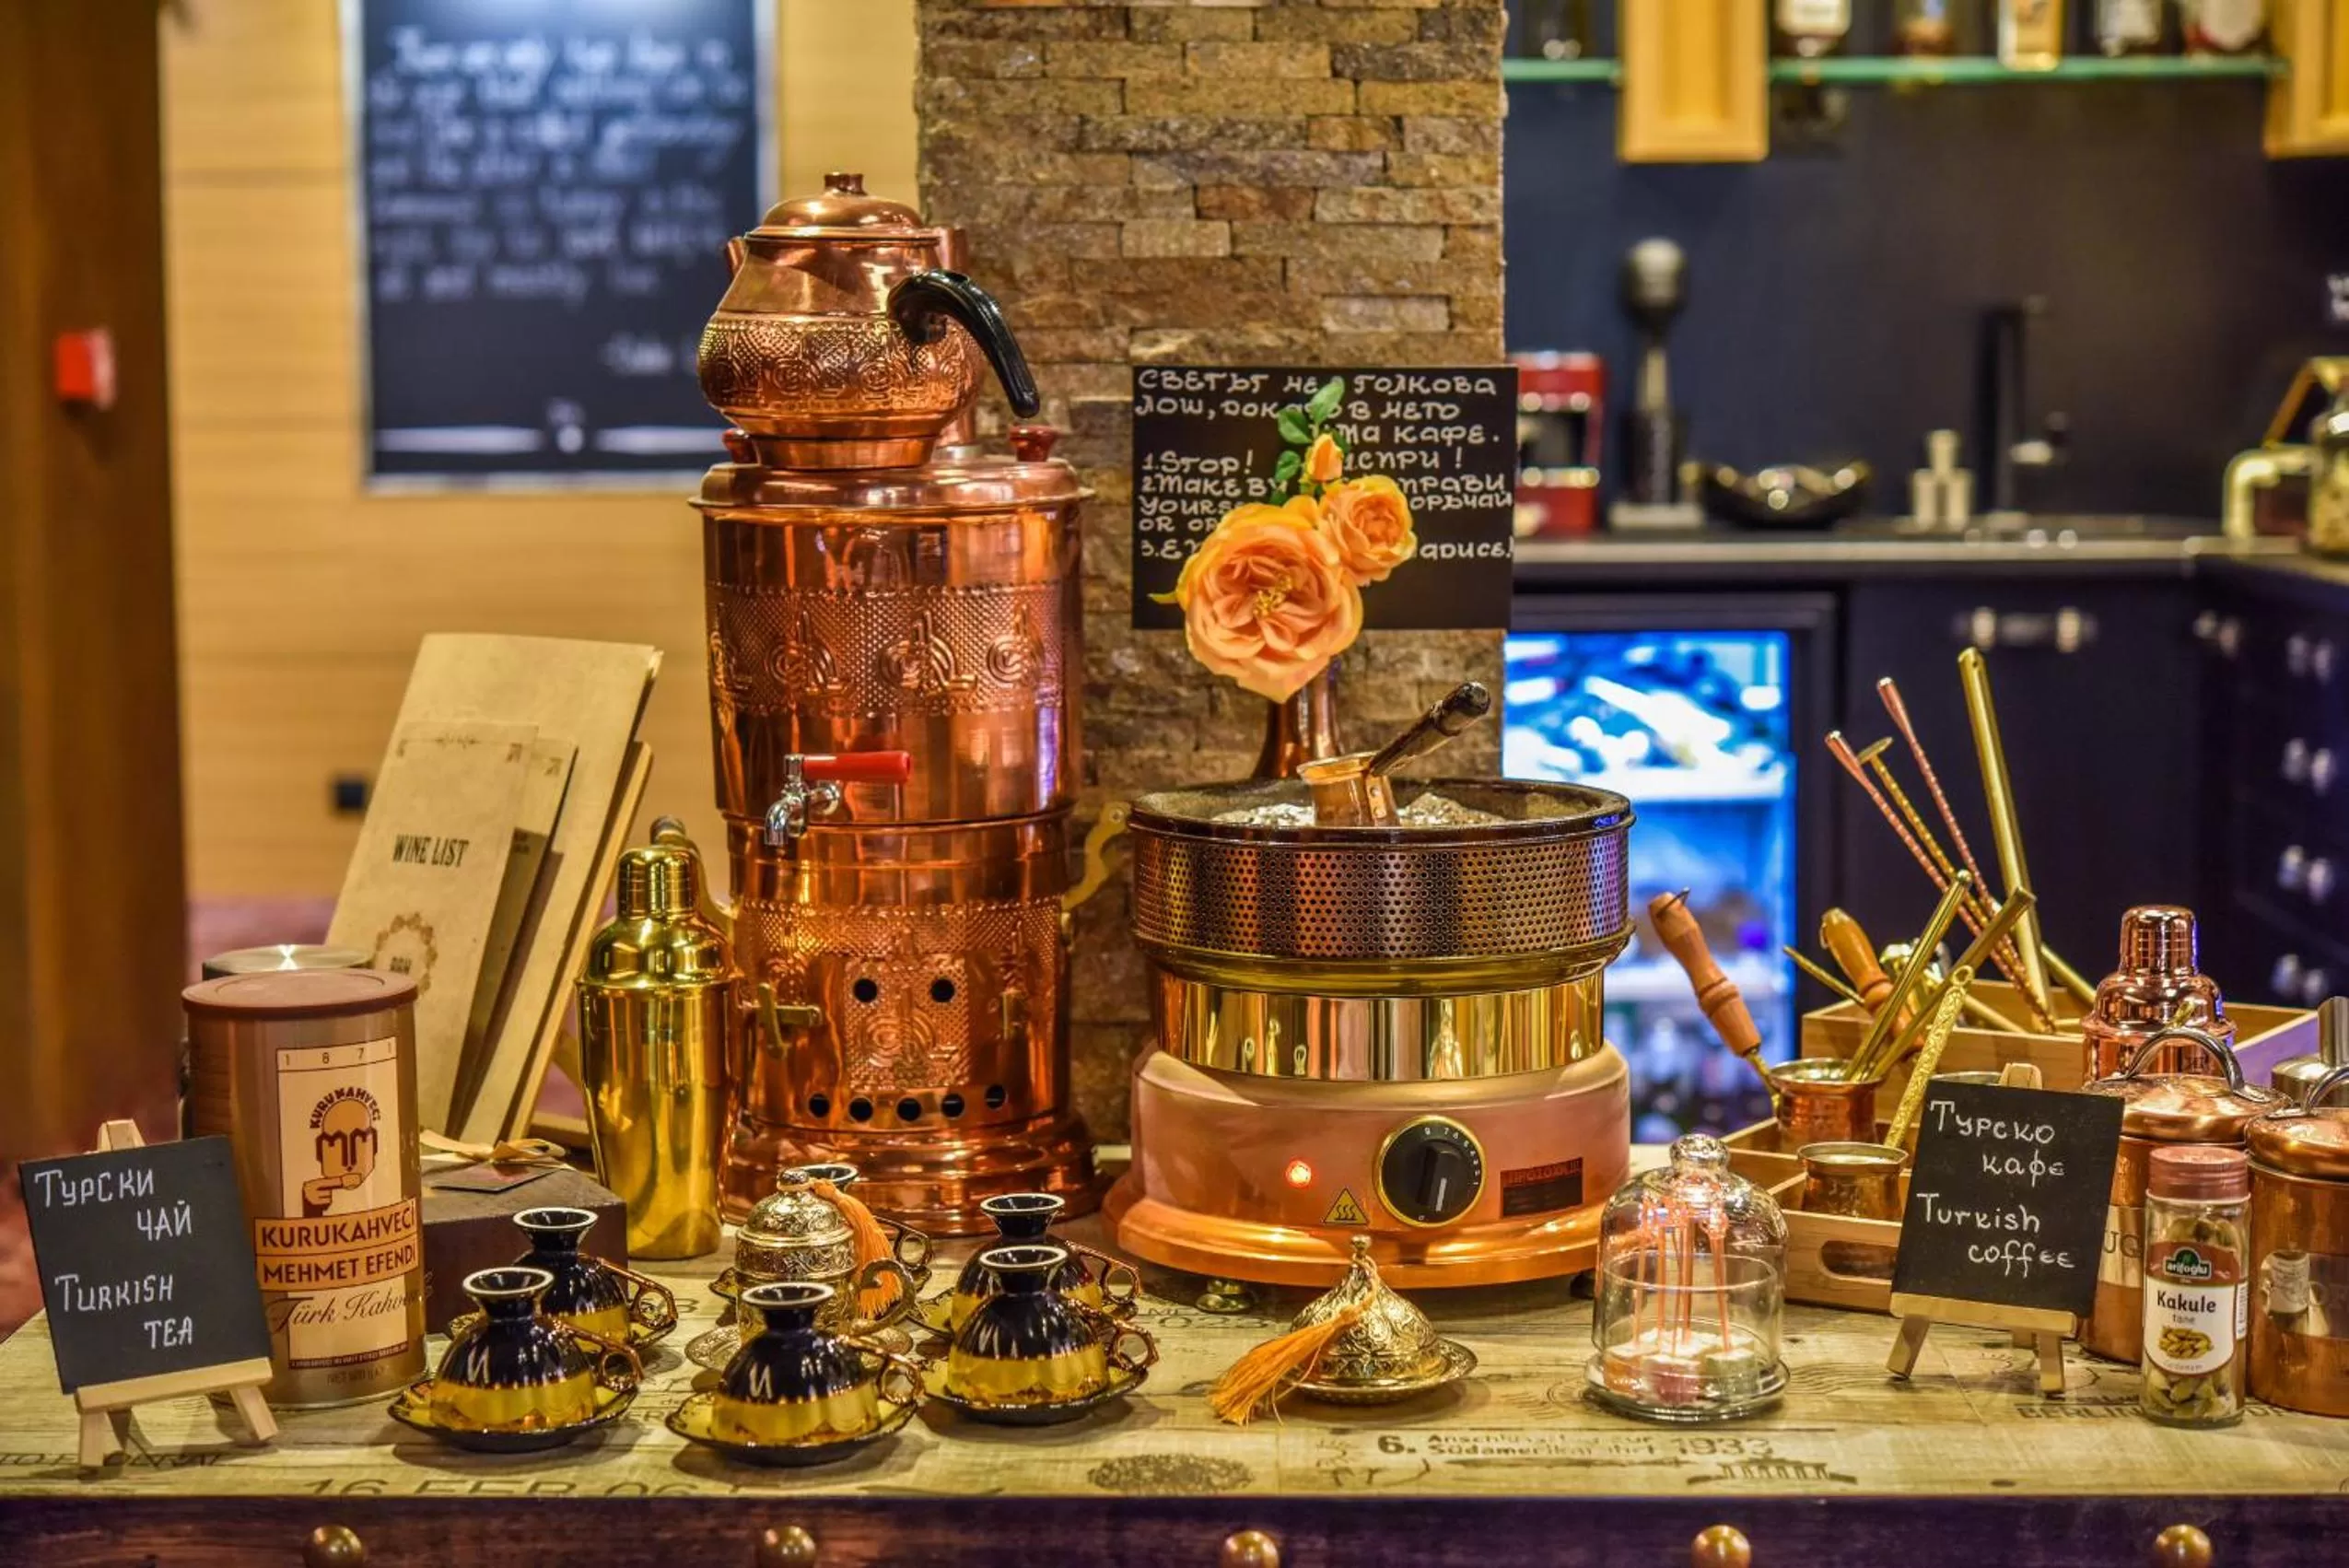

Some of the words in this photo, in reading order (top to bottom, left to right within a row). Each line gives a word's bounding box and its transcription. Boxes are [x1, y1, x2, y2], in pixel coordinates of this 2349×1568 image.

[392, 833, 430, 864] WINE
[430, 837, 470, 868] LIST
[1916, 1192, 2040, 1234] Turkish
[263, 1257, 359, 1284] MEHMET
[1968, 1240, 2075, 1278] coffee
[269, 1296, 338, 1335] Türk
[2156, 1290, 2217, 1314] Kakule
[145, 1316, 193, 1350] TEA
